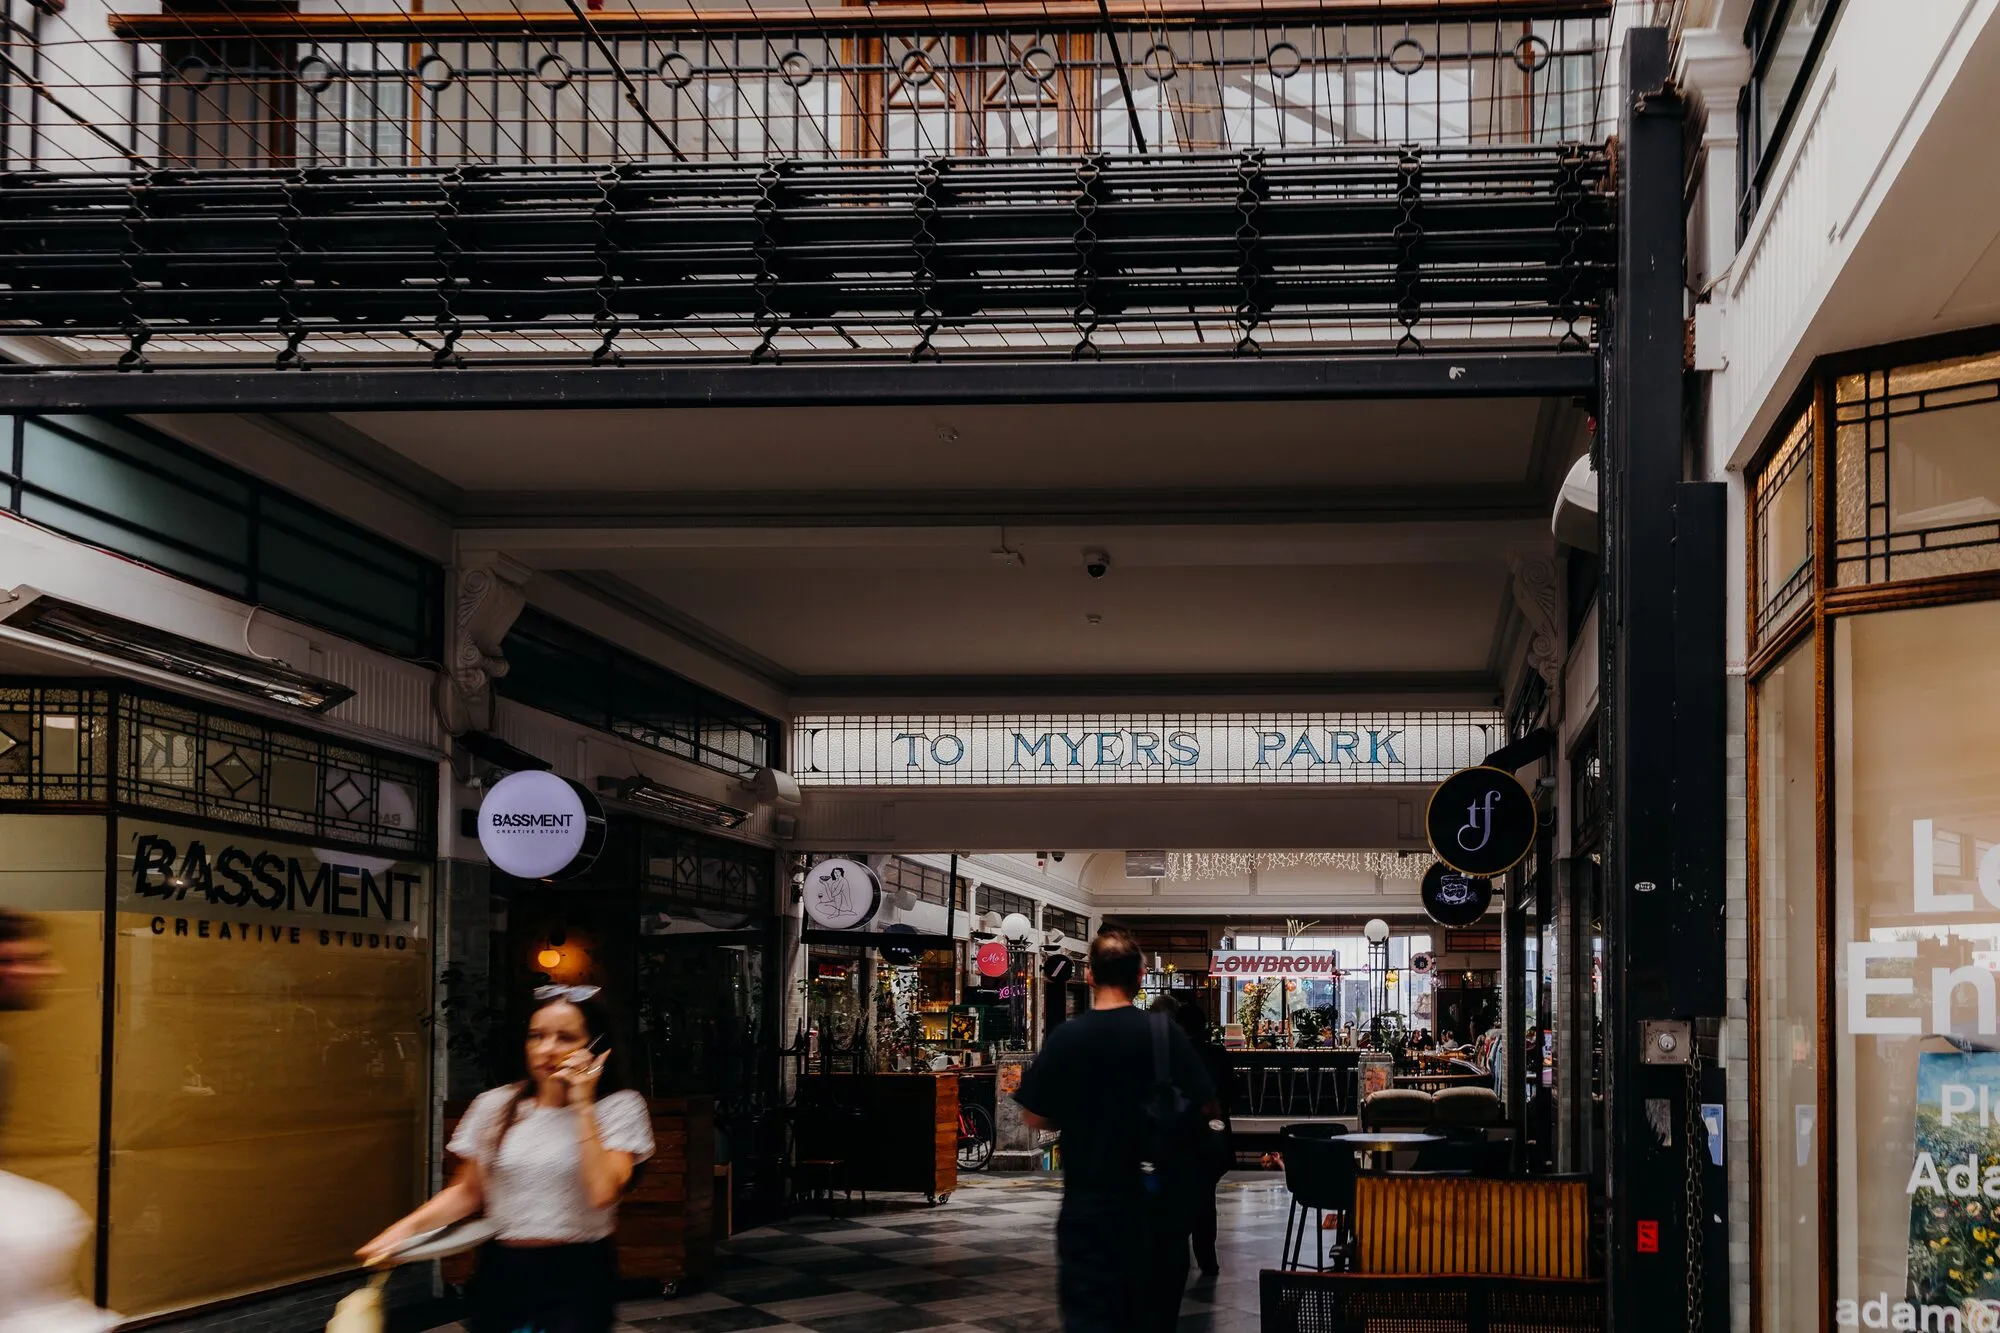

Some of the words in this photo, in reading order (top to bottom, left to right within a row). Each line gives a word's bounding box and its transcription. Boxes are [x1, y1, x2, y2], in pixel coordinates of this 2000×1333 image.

[894, 732, 964, 766] TO
[1010, 731, 1200, 768] MYERS
[1254, 730, 1403, 764] PARK
[492, 813, 574, 827] BASSMENT
[132, 832, 421, 922] BASSMENT
[1912, 818, 2000, 914] L
[151, 915, 301, 945] CREATIVE
[319, 929, 406, 951] STUDIO
[981, 952, 1005, 965] Mo's
[1209, 955, 1334, 973] LOWBROW
[1941, 1083, 2000, 1128] Pl
